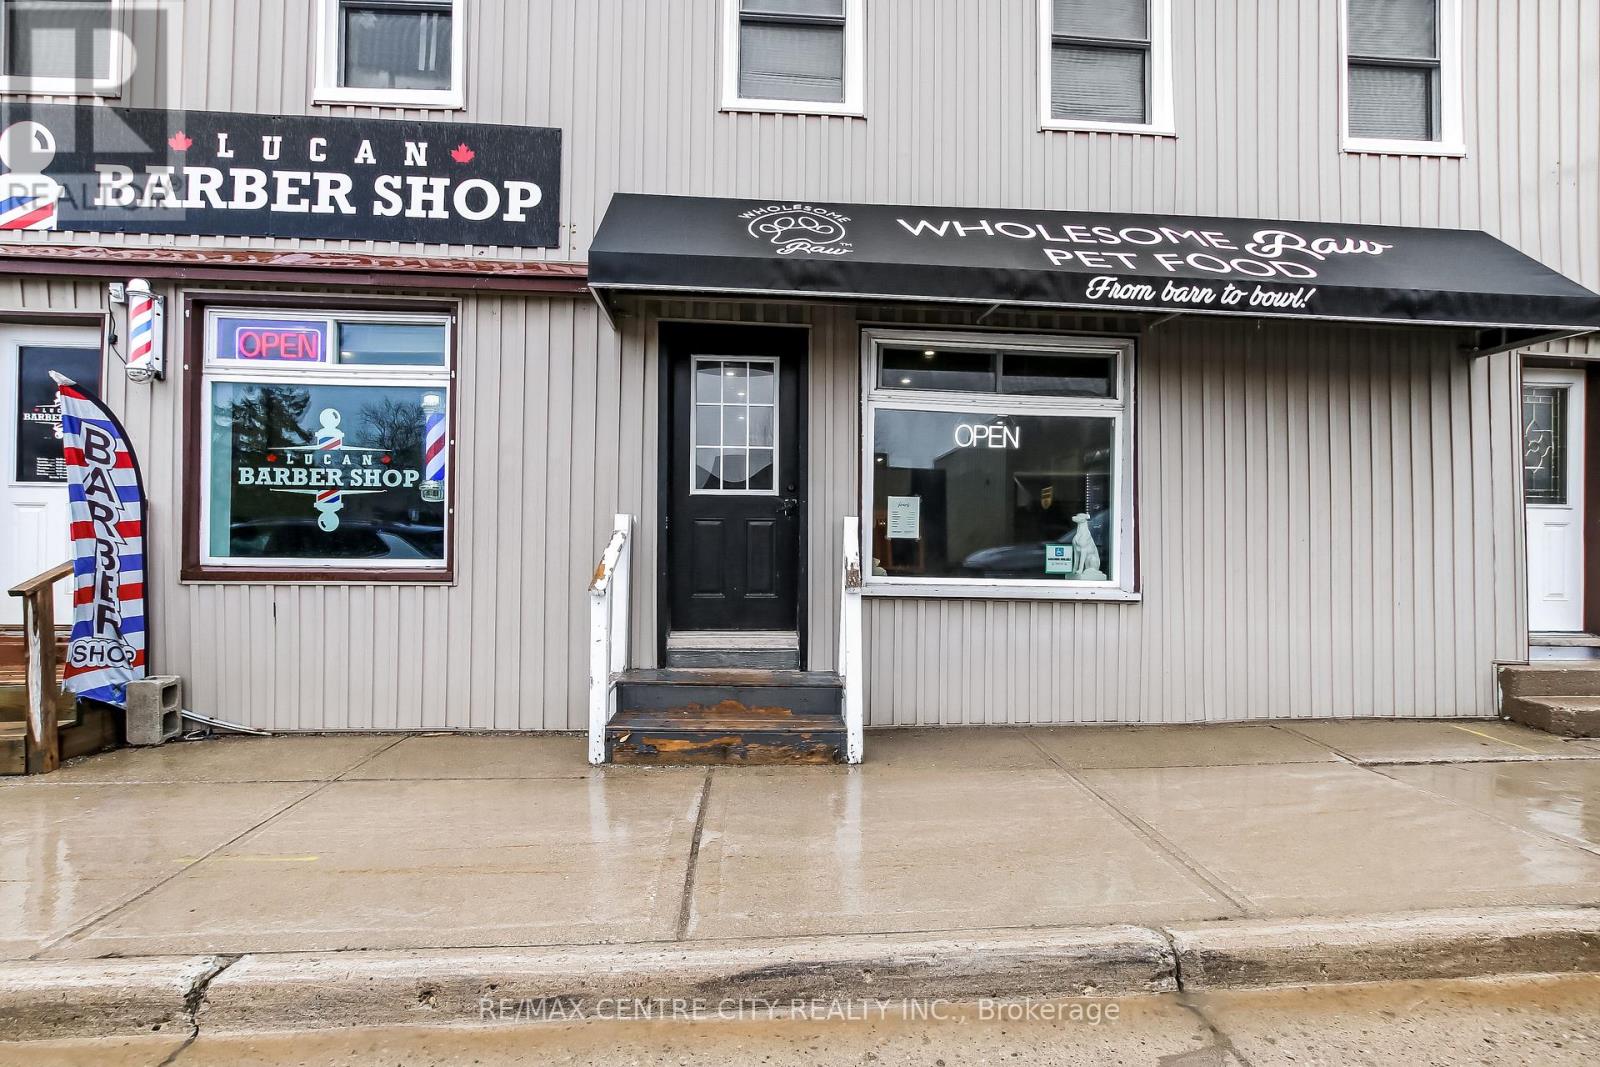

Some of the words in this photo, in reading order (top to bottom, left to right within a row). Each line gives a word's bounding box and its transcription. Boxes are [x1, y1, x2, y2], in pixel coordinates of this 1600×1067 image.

[217, 133, 427, 166] LUCAN
[94, 163, 357, 215] BARBER
[373, 174, 543, 222] SHOP
[738, 204, 852, 223] WHOLESOME
[776, 242, 853, 255] Raw
[896, 218, 1239, 250] WHOLESOME
[1244, 229, 1393, 260] Raw
[1043, 248, 1137, 269] PET
[1153, 253, 1318, 279] FOOD
[1085, 276, 1156, 300] From
[1160, 280, 1216, 304] barn
[1220, 282, 1249, 305] to
[1249, 284, 1317, 309] bowl!
[239, 331, 319, 359] OPEN
[23, 412, 62, 421] BARBE
[954, 423, 1020, 449] OPEN
[286, 453, 373, 466] LUCAN
[238, 467, 344, 487] BARBER
[350, 468, 420, 488] SHOP
[84, 427, 123, 640] BARBER
